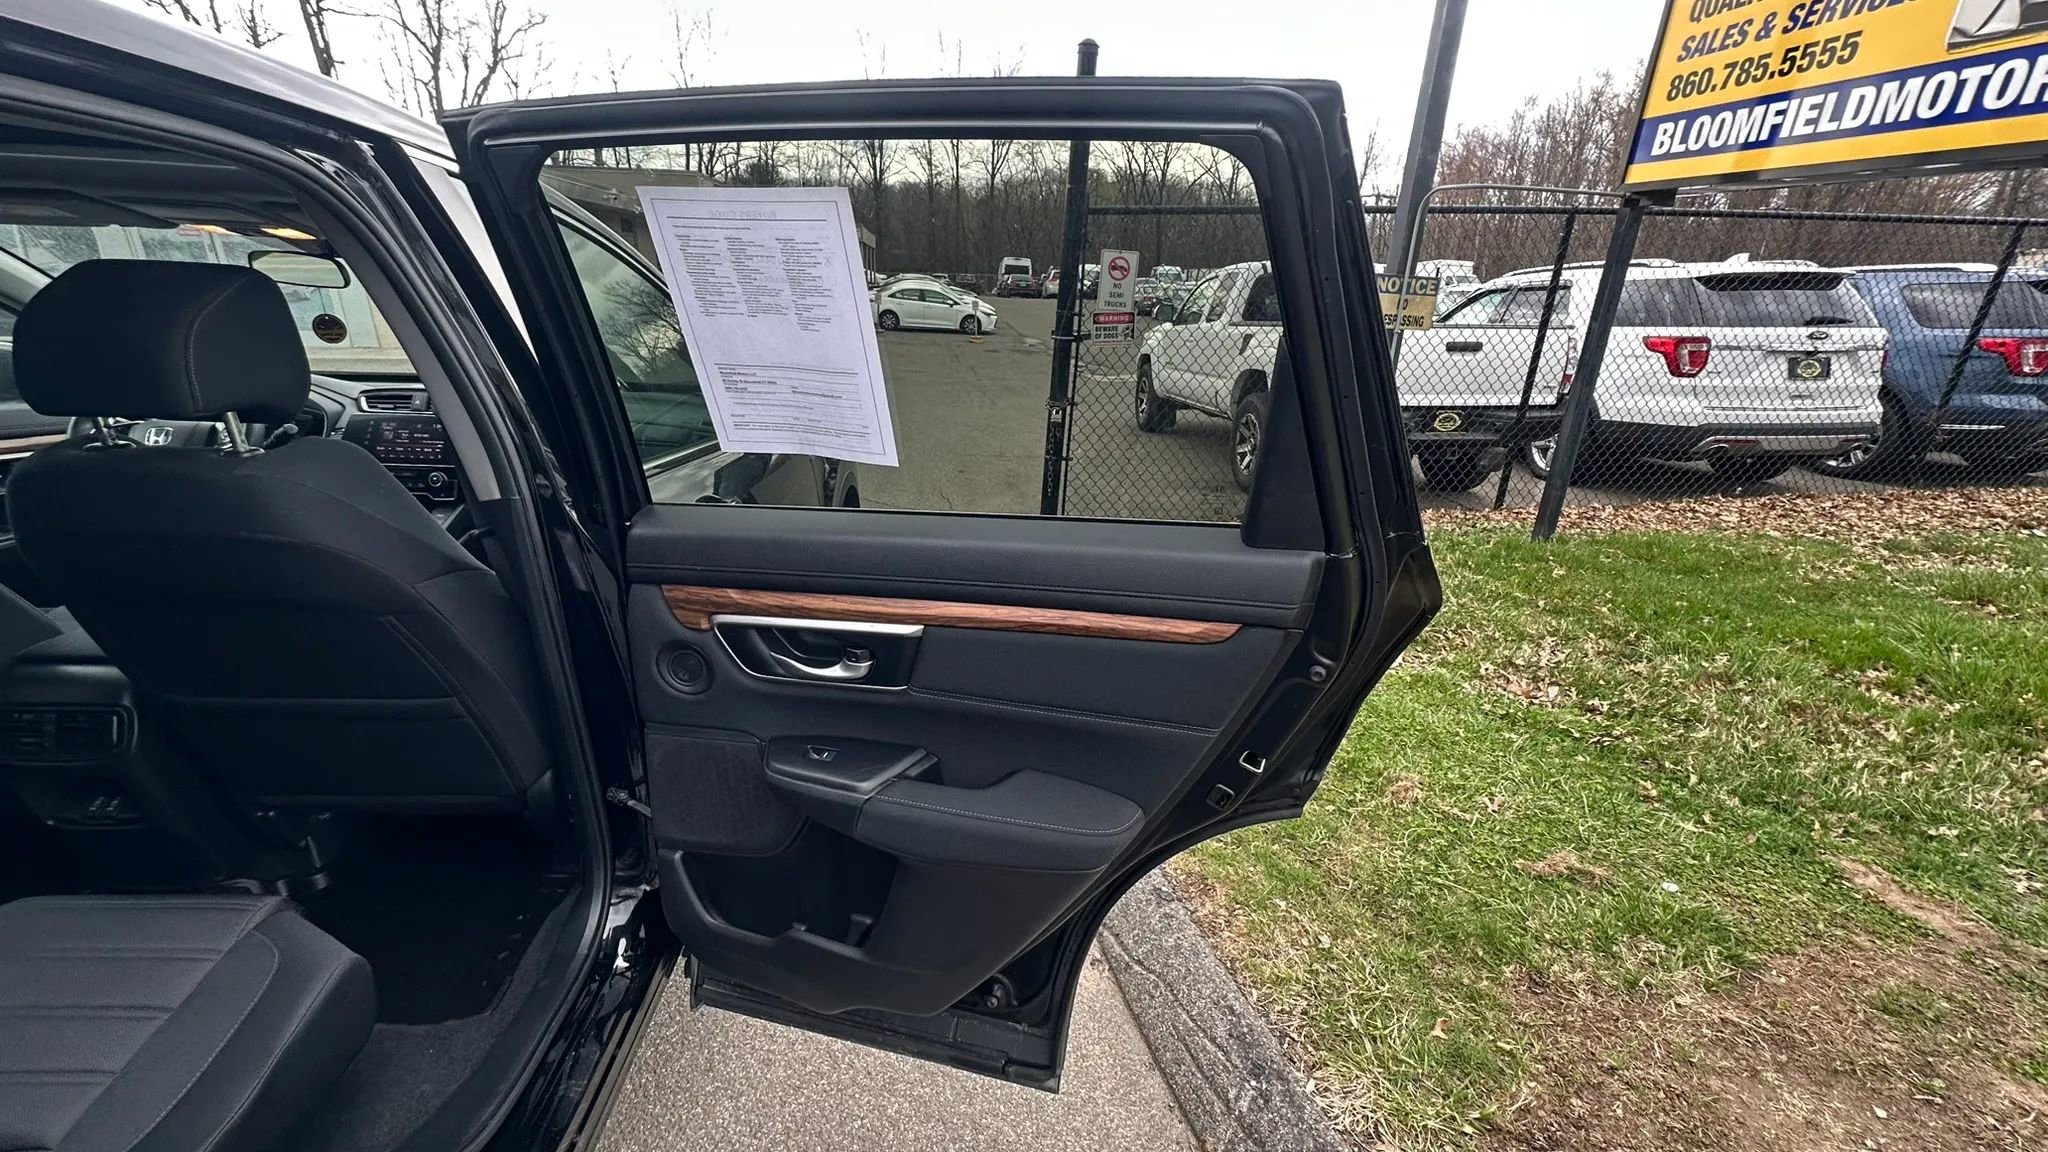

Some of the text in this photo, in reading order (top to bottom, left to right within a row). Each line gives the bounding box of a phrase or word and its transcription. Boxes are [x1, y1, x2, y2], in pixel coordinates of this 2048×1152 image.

[1690, 0, 1761, 23] QUA
[1677, 0, 1915, 63] SALES & SERVI
[1666, 31, 1863, 102] 860.785.5555
[1103, 300, 1127, 308] TRUCKS
[1108, 291, 1125, 299] SEMI
[1384, 313, 1425, 327] ESPSSING
